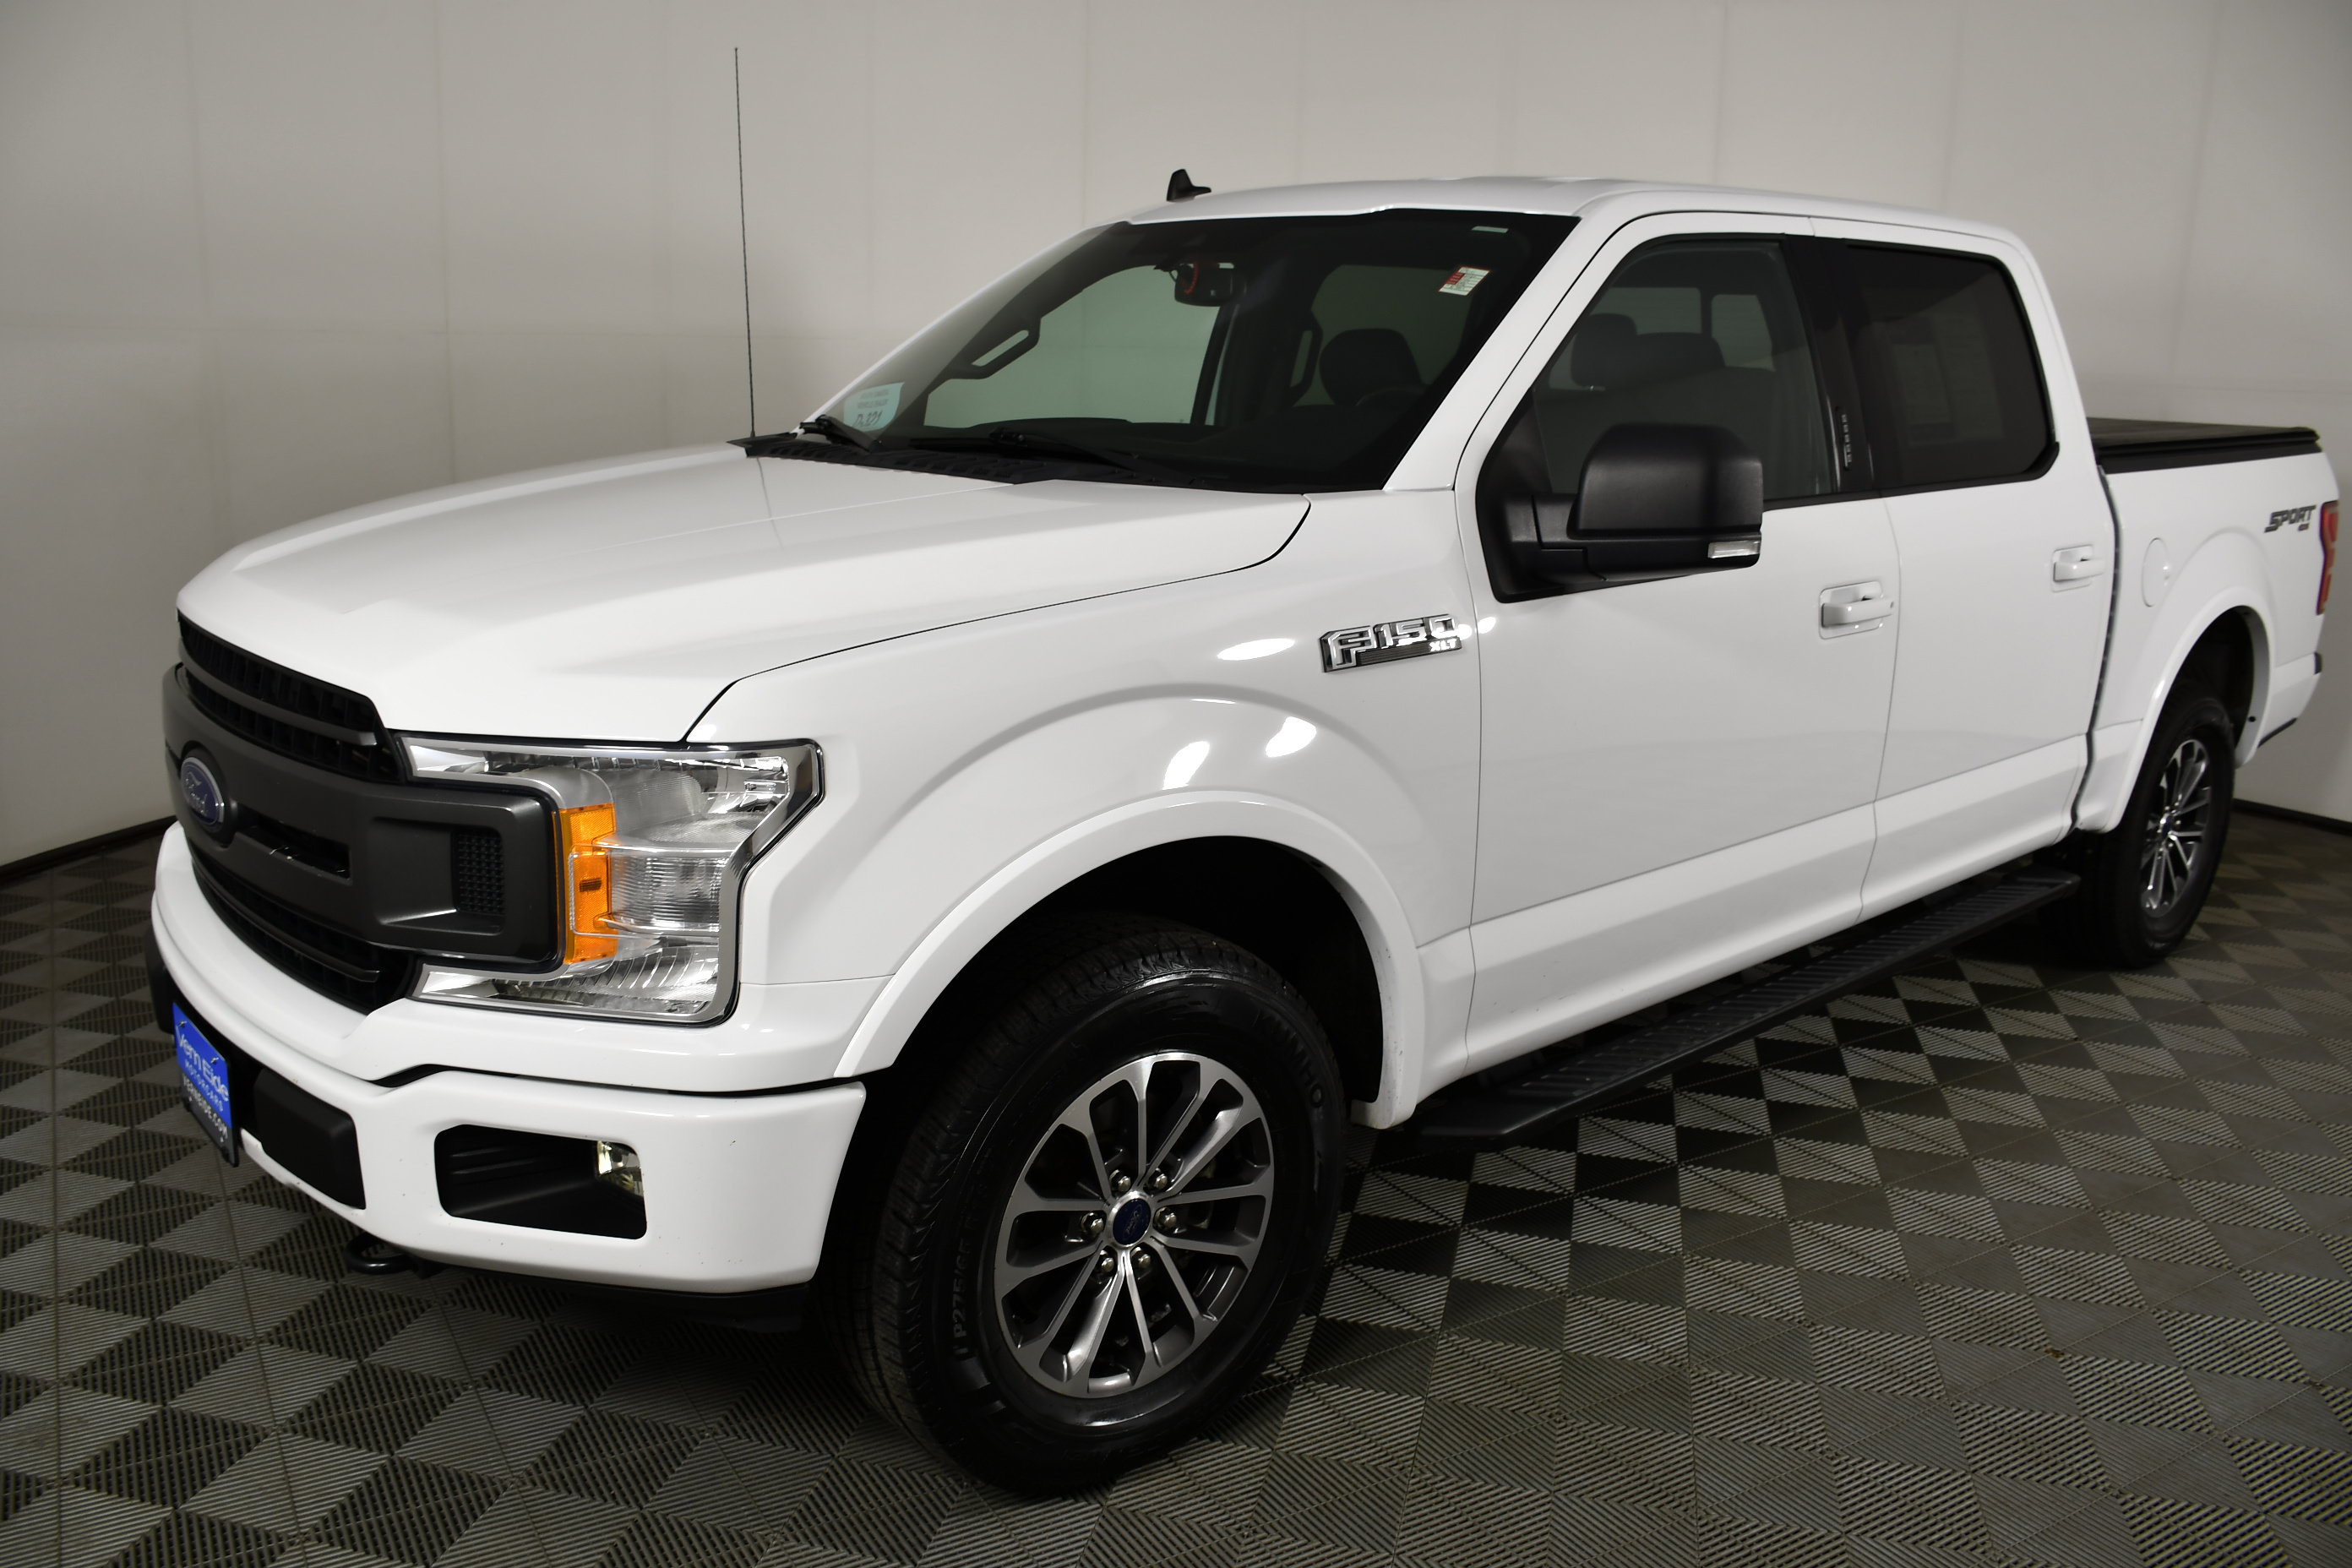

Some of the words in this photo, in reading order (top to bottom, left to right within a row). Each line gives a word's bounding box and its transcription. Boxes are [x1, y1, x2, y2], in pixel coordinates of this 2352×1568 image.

[2263, 504, 2317, 533] SPORT
[1429, 637, 1457, 652] XLT
[175, 1025, 202, 1071] Vern
[202, 1058, 229, 1102] Eide
